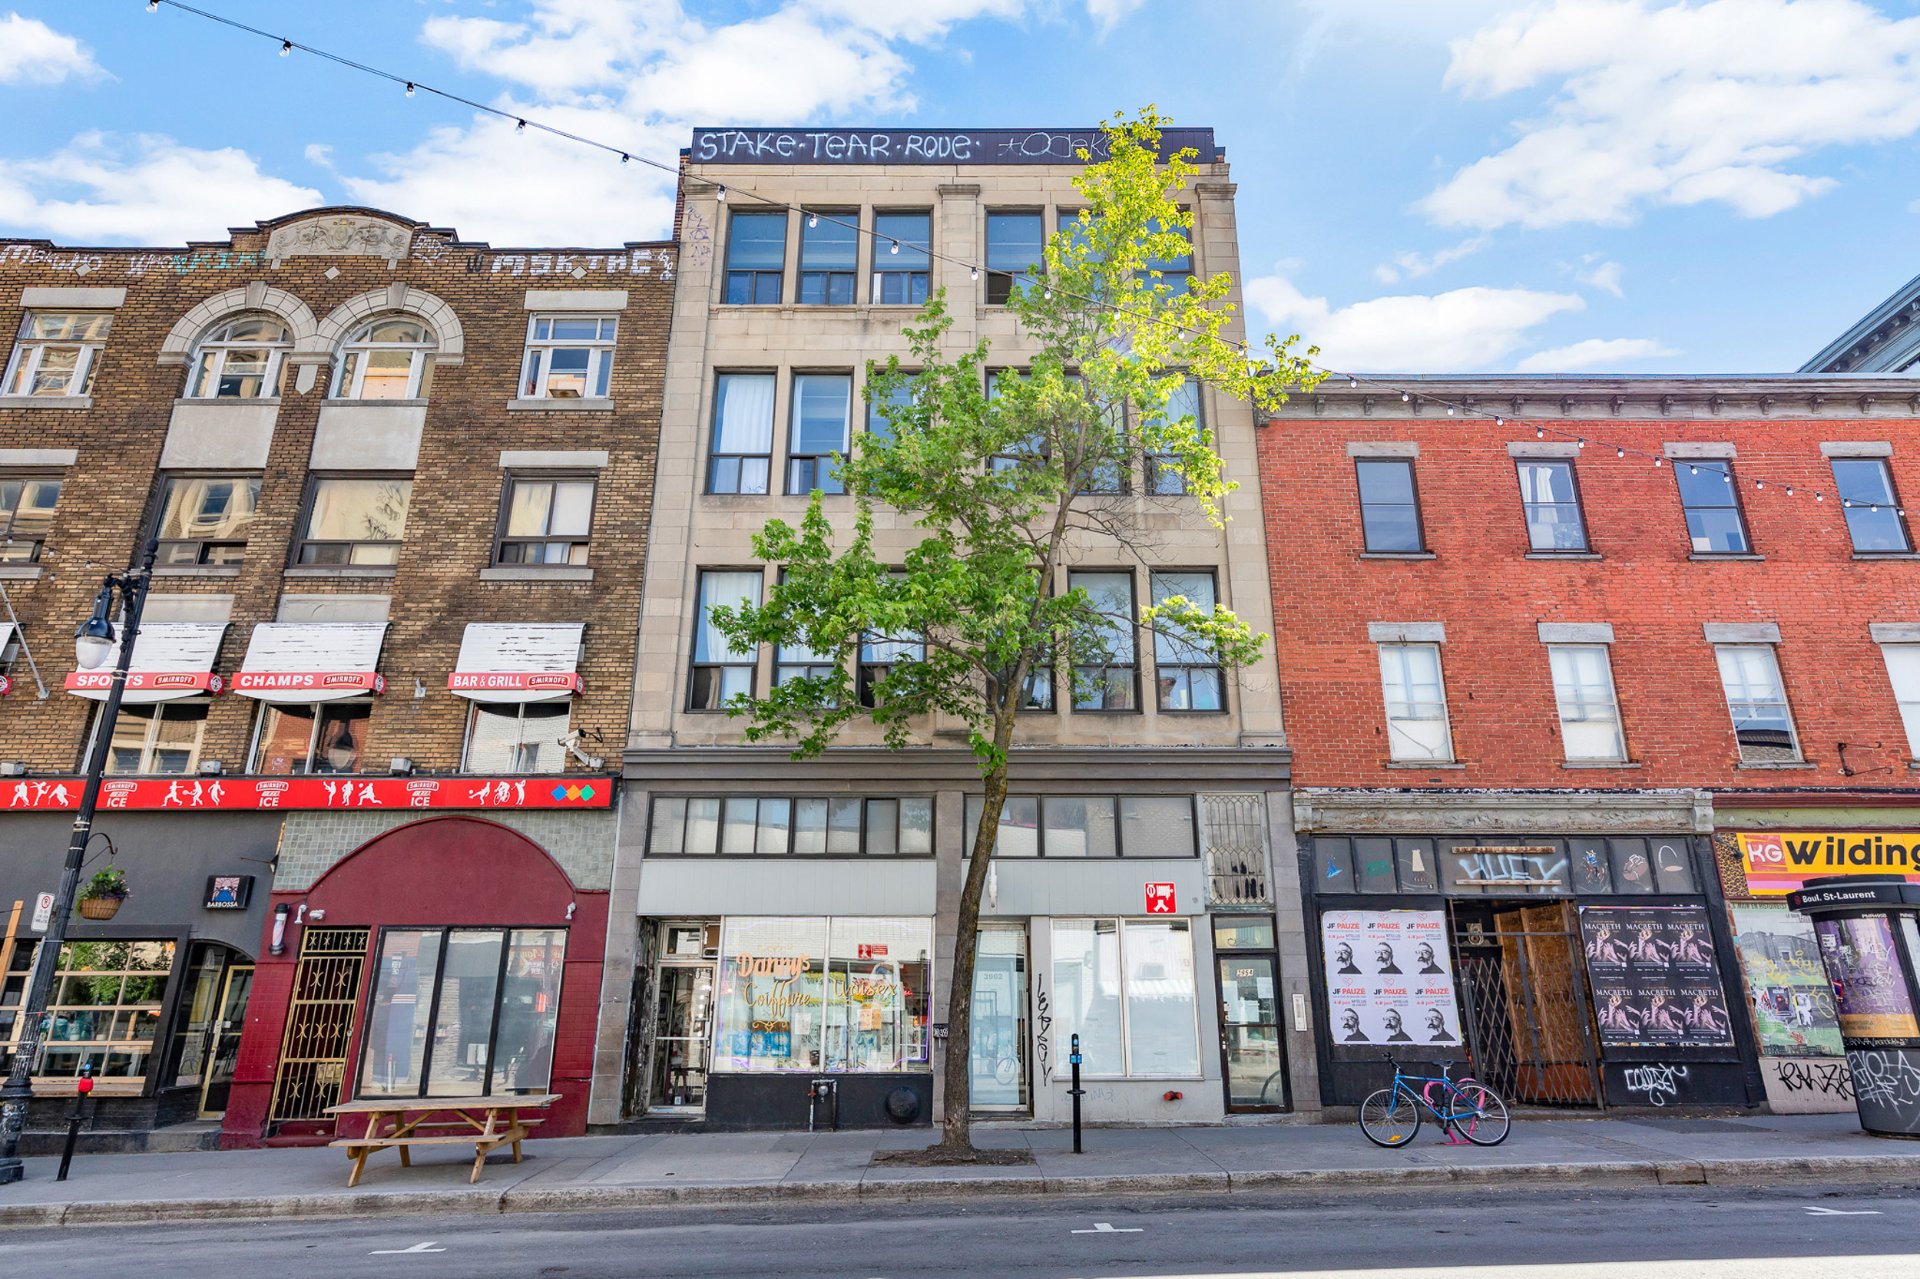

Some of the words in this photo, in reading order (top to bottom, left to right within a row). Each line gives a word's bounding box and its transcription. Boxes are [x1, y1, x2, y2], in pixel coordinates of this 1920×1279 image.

[76, 674, 144, 688] SPOTS
[240, 674, 314, 687] CHAMPS
[453, 675, 478, 688] BAR
[479, 676, 486, 688] &
[487, 675, 522, 688] GRILL
[106, 797, 127, 808] ICE
[259, 797, 280, 807] ICE
[410, 796, 430, 807] ICE
[1746, 843, 1784, 864] KG
[1801, 893, 1822, 904] Boul.
[1823, 890, 1876, 901] St-Laurent
[1327, 922, 1336, 930] JF
[1367, 922, 1377, 930] JF
[1584, 922, 1621, 930] MACBETH
[1626, 922, 1663, 930] MACBETH
[1667, 922, 1705, 930] MACBETH
[830, 977, 898, 999] Unisex
[1596, 988, 1633, 996] MACBETH
[1638, 988, 1676, 996] MACBETH
[1680, 988, 1719, 996] MACBETH
[743, 980, 811, 1018] Coiffure
